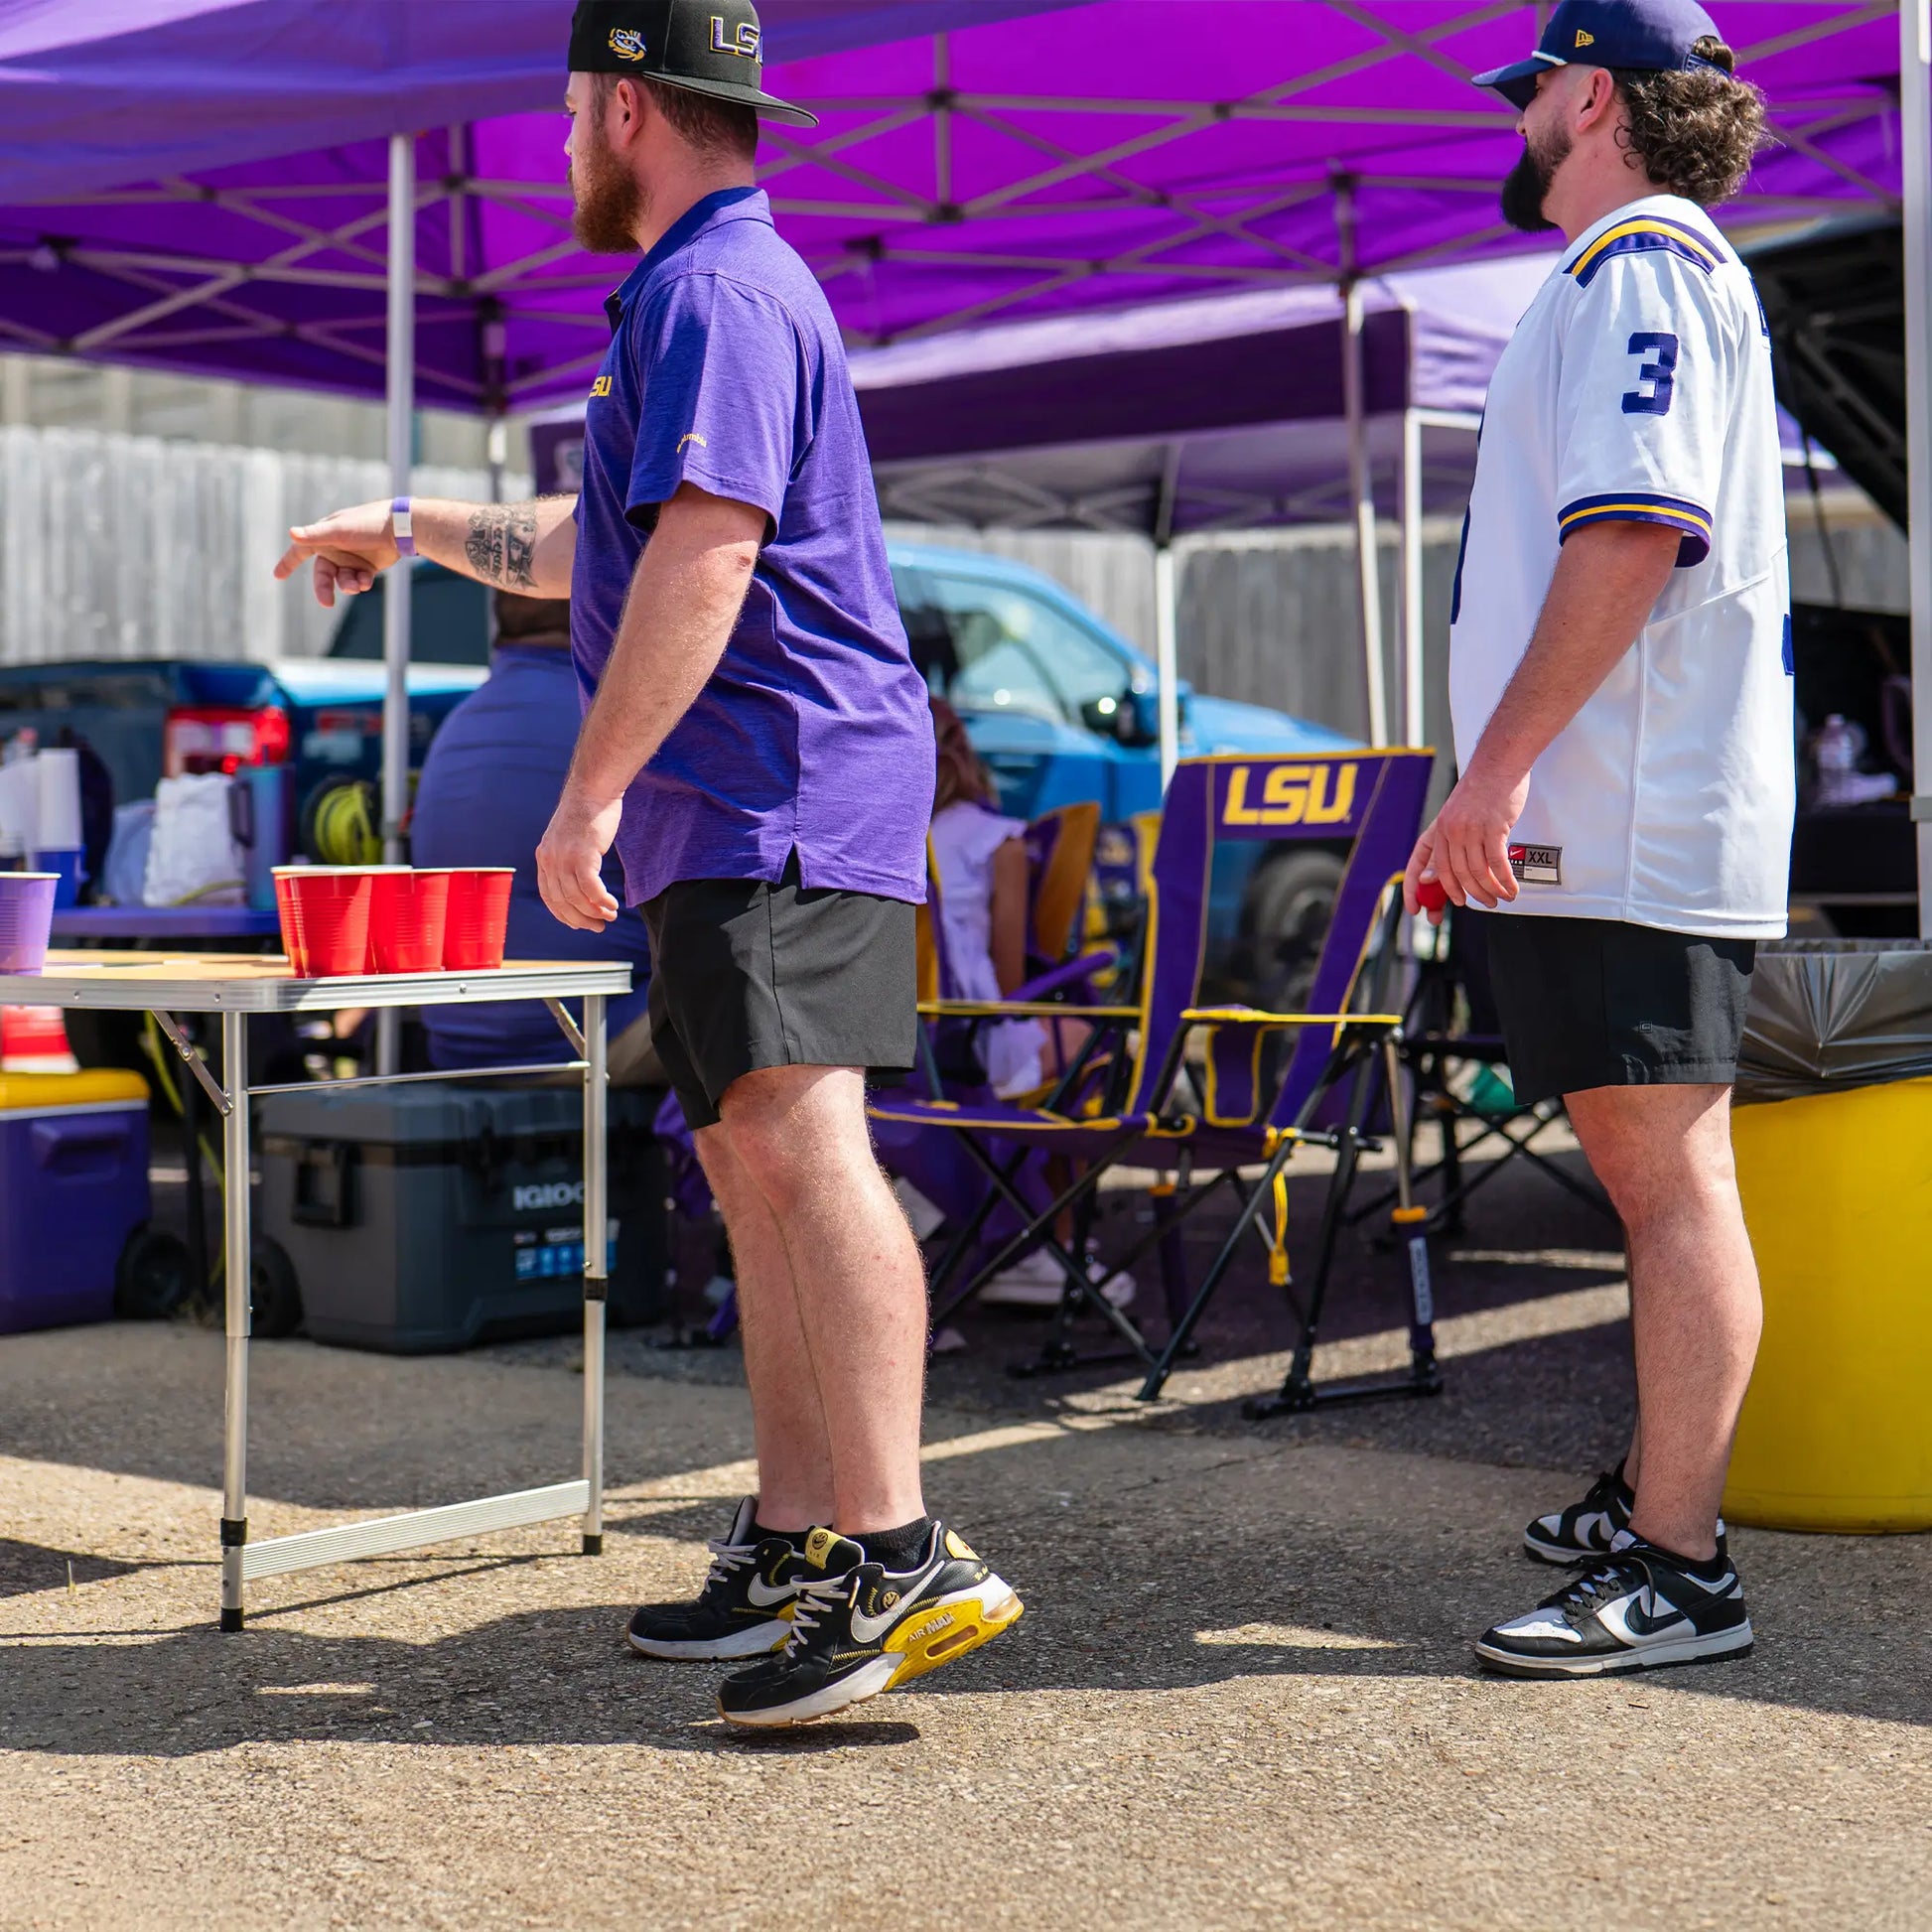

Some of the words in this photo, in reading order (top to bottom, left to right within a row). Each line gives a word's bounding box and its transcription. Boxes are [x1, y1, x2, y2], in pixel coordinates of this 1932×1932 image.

[710, 16, 763, 68] LS
[1621, 332, 1679, 416] 3
[588, 376, 612, 397] SU
[676, 433, 707, 454] lumbia
[1222, 762, 1358, 825] LSU
[1529, 851, 1553, 864] XXL
[908, 1628, 926, 1643] AIR
